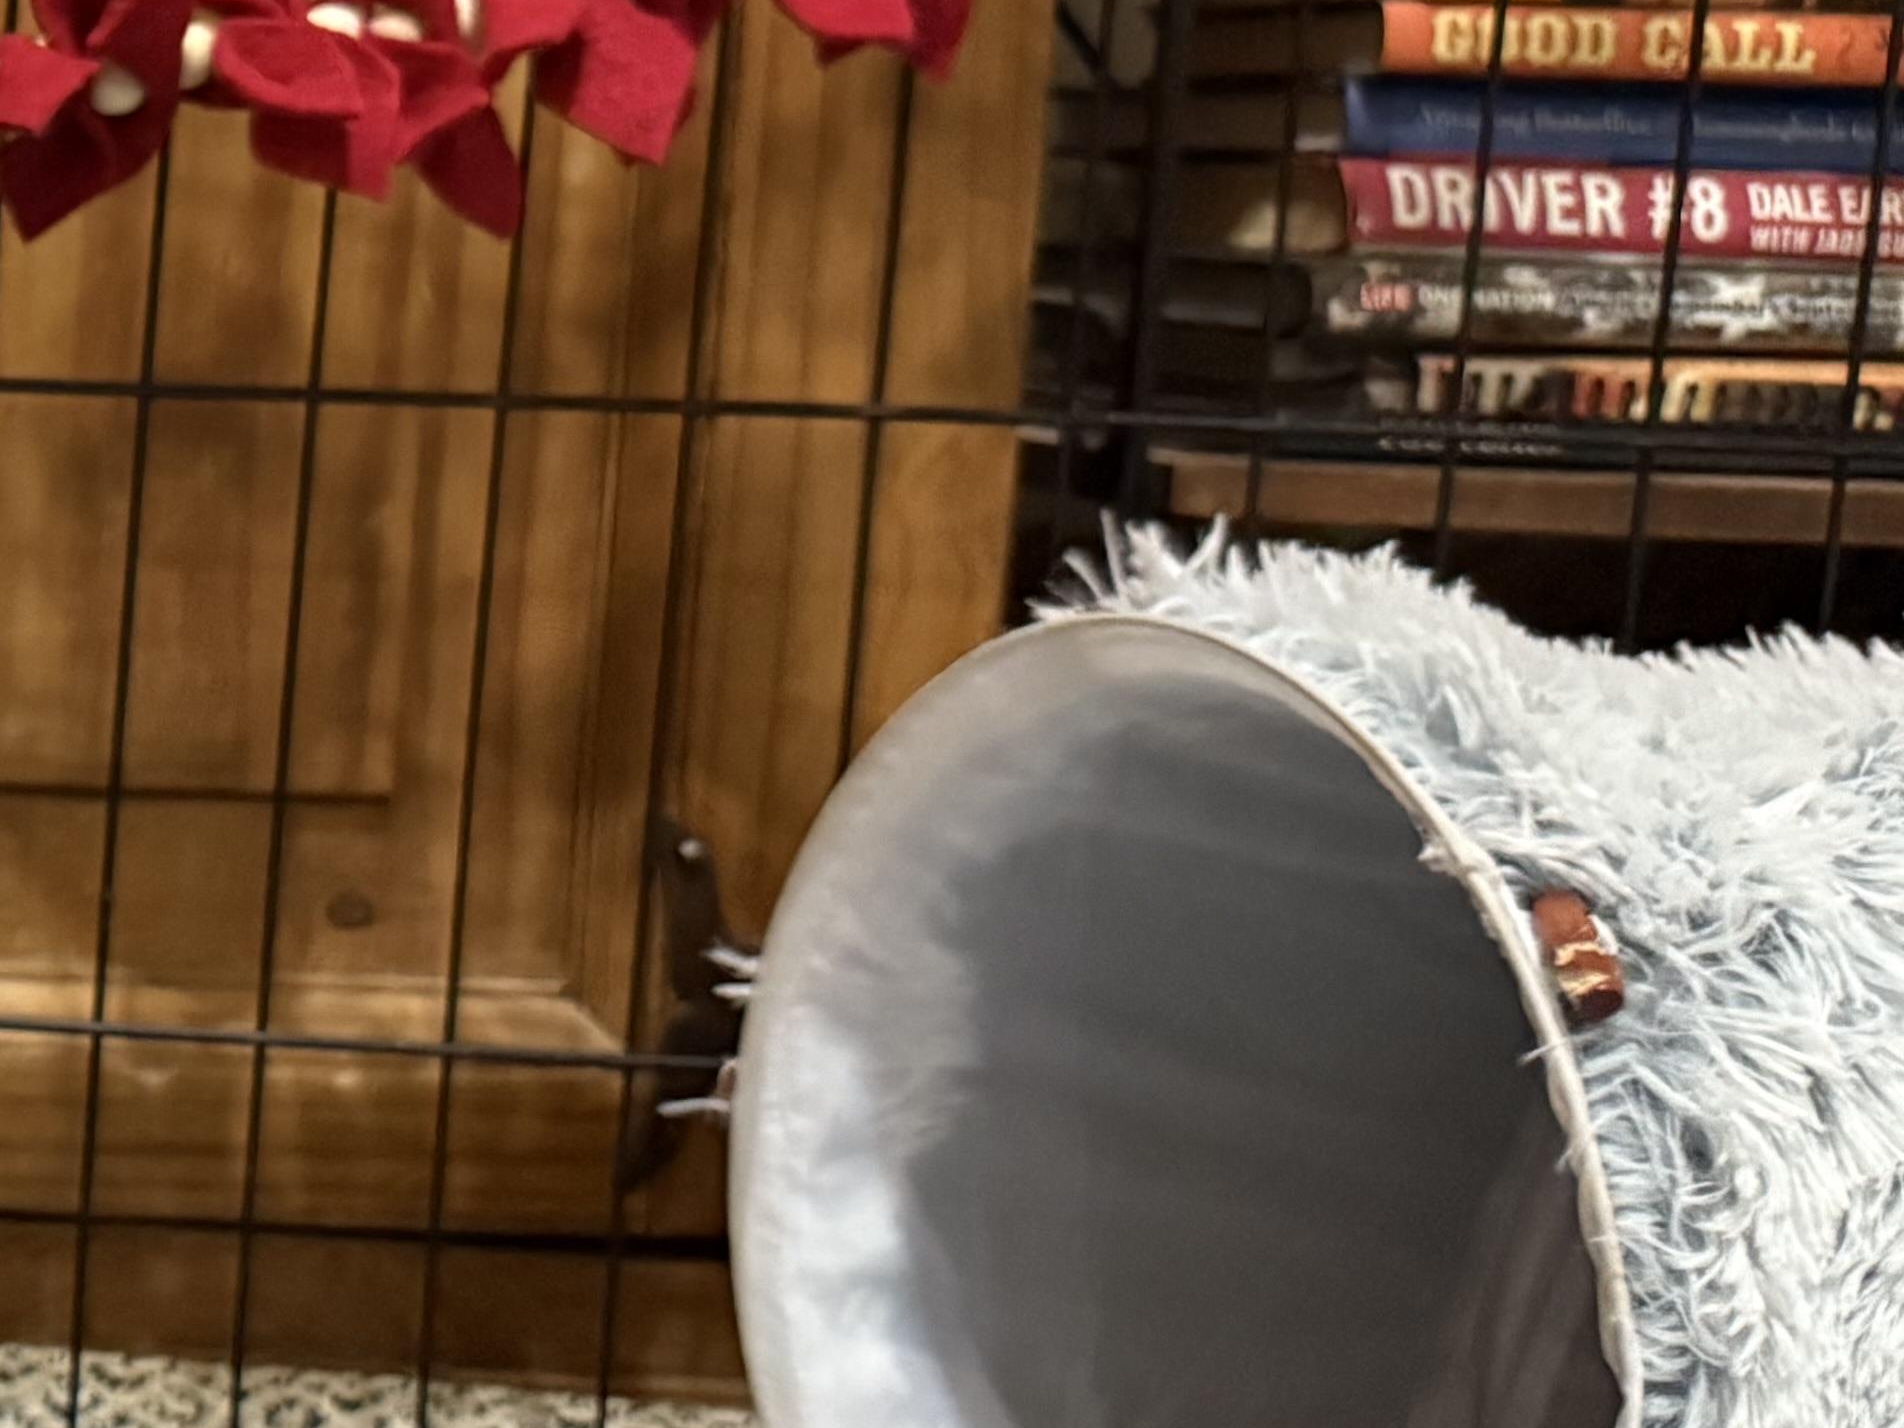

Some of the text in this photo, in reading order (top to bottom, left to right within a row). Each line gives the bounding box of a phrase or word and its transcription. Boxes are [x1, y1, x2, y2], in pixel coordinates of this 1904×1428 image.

[1430, 8, 1817, 73] GOOD CALL
[1385, 165, 1729, 244] DRIVER #8
[1746, 181, 1833, 224] DALE
